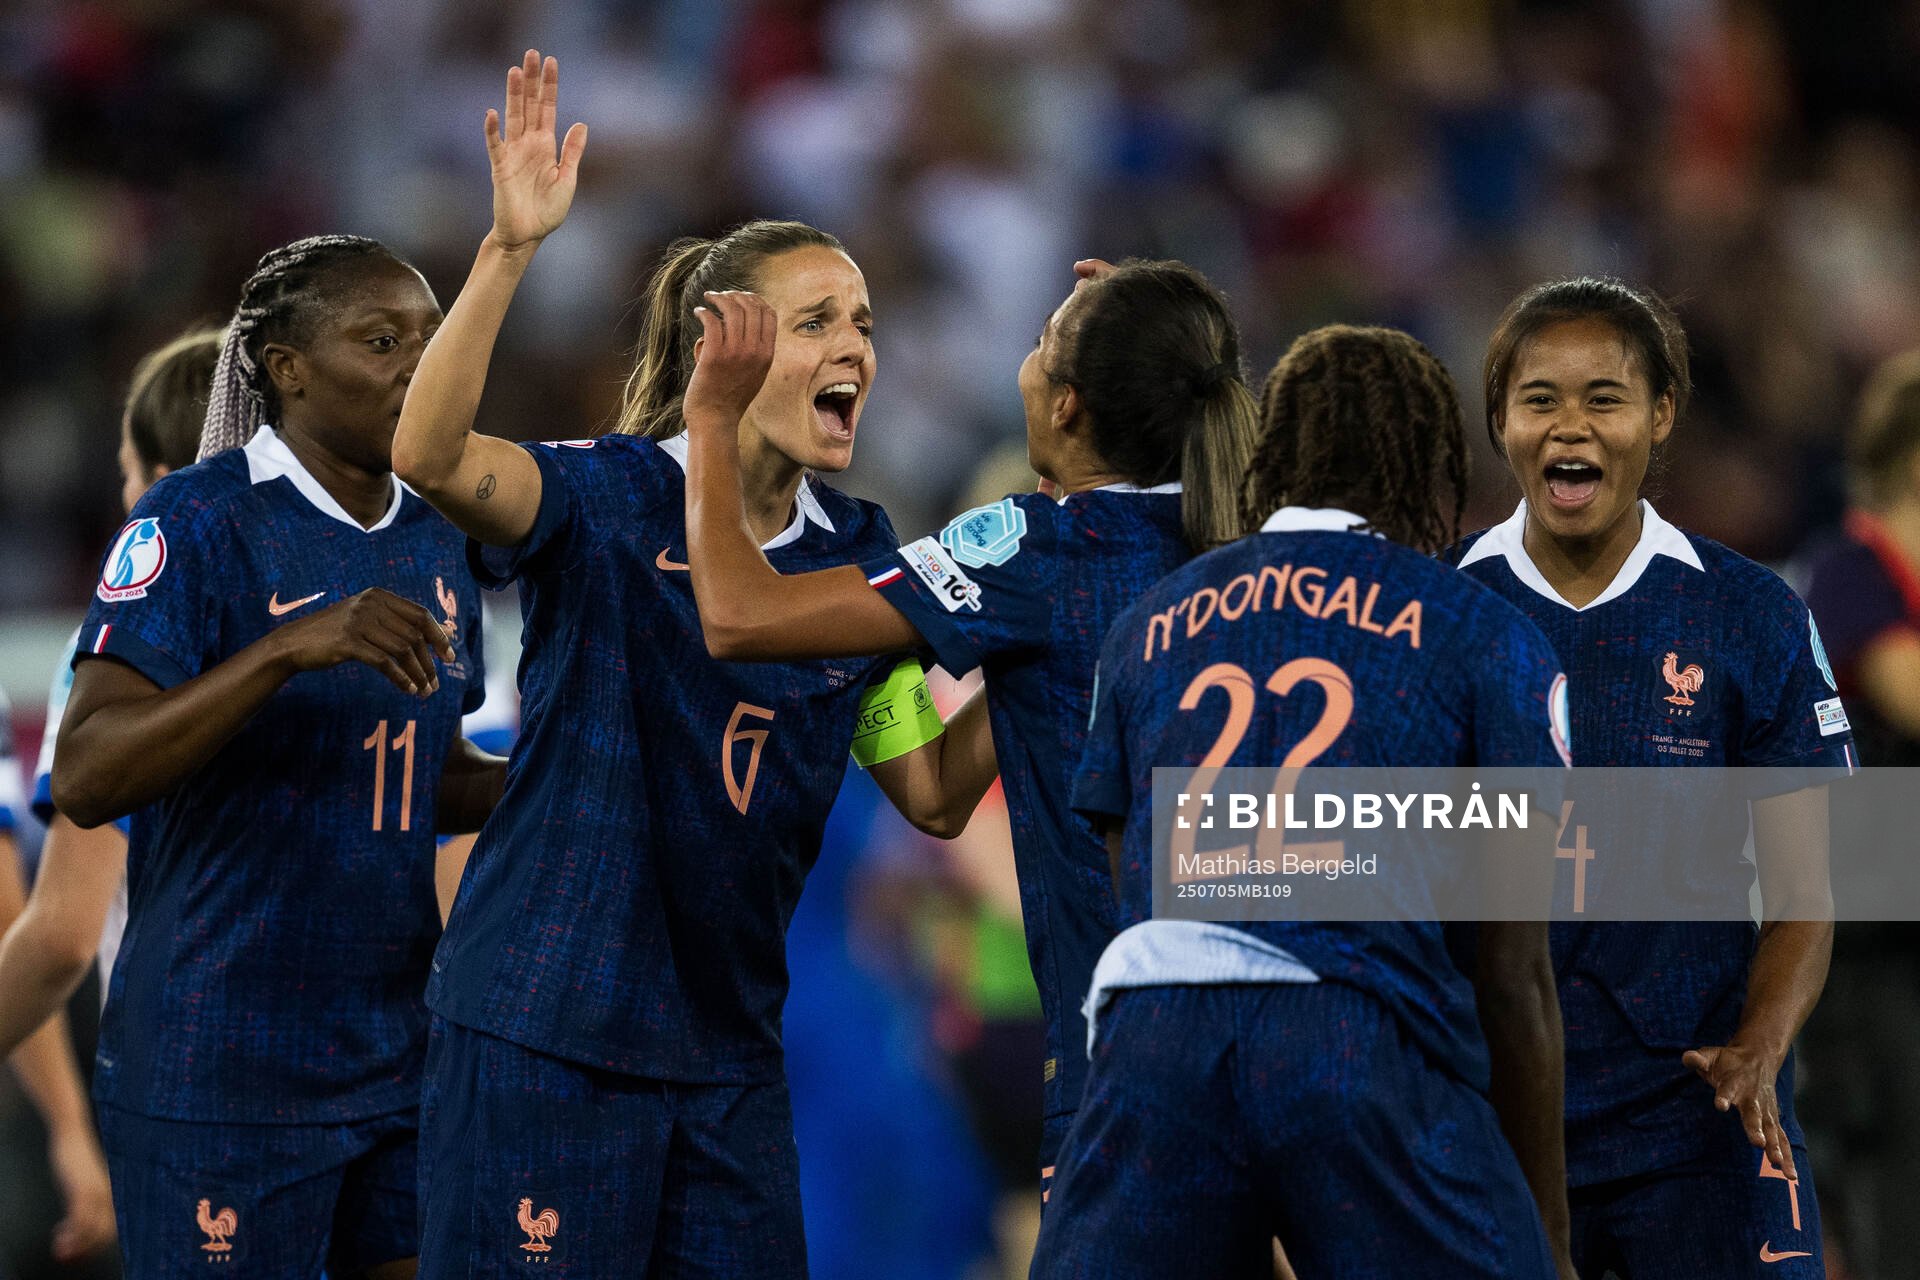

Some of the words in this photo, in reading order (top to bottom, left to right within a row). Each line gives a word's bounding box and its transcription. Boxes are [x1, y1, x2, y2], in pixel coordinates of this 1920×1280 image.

[125, 589, 145, 598] 2025
[1143, 564, 1423, 662] N'DONGALA
[722, 701, 775, 816] 6
[854, 705, 895, 734] PECT
[1652, 734, 1674, 744] FRANCE
[1679, 737, 1710, 748] ANGLETERRE
[1657, 744, 1668, 753] 05
[1669, 746, 1687, 755] JUILLET
[1688, 748, 1704, 757] 2025
[363, 719, 416, 831] 11
[1170, 657, 1355, 885] 22
[1555, 800, 1596, 913] 4
[1759, 1150, 1801, 1231] 4
